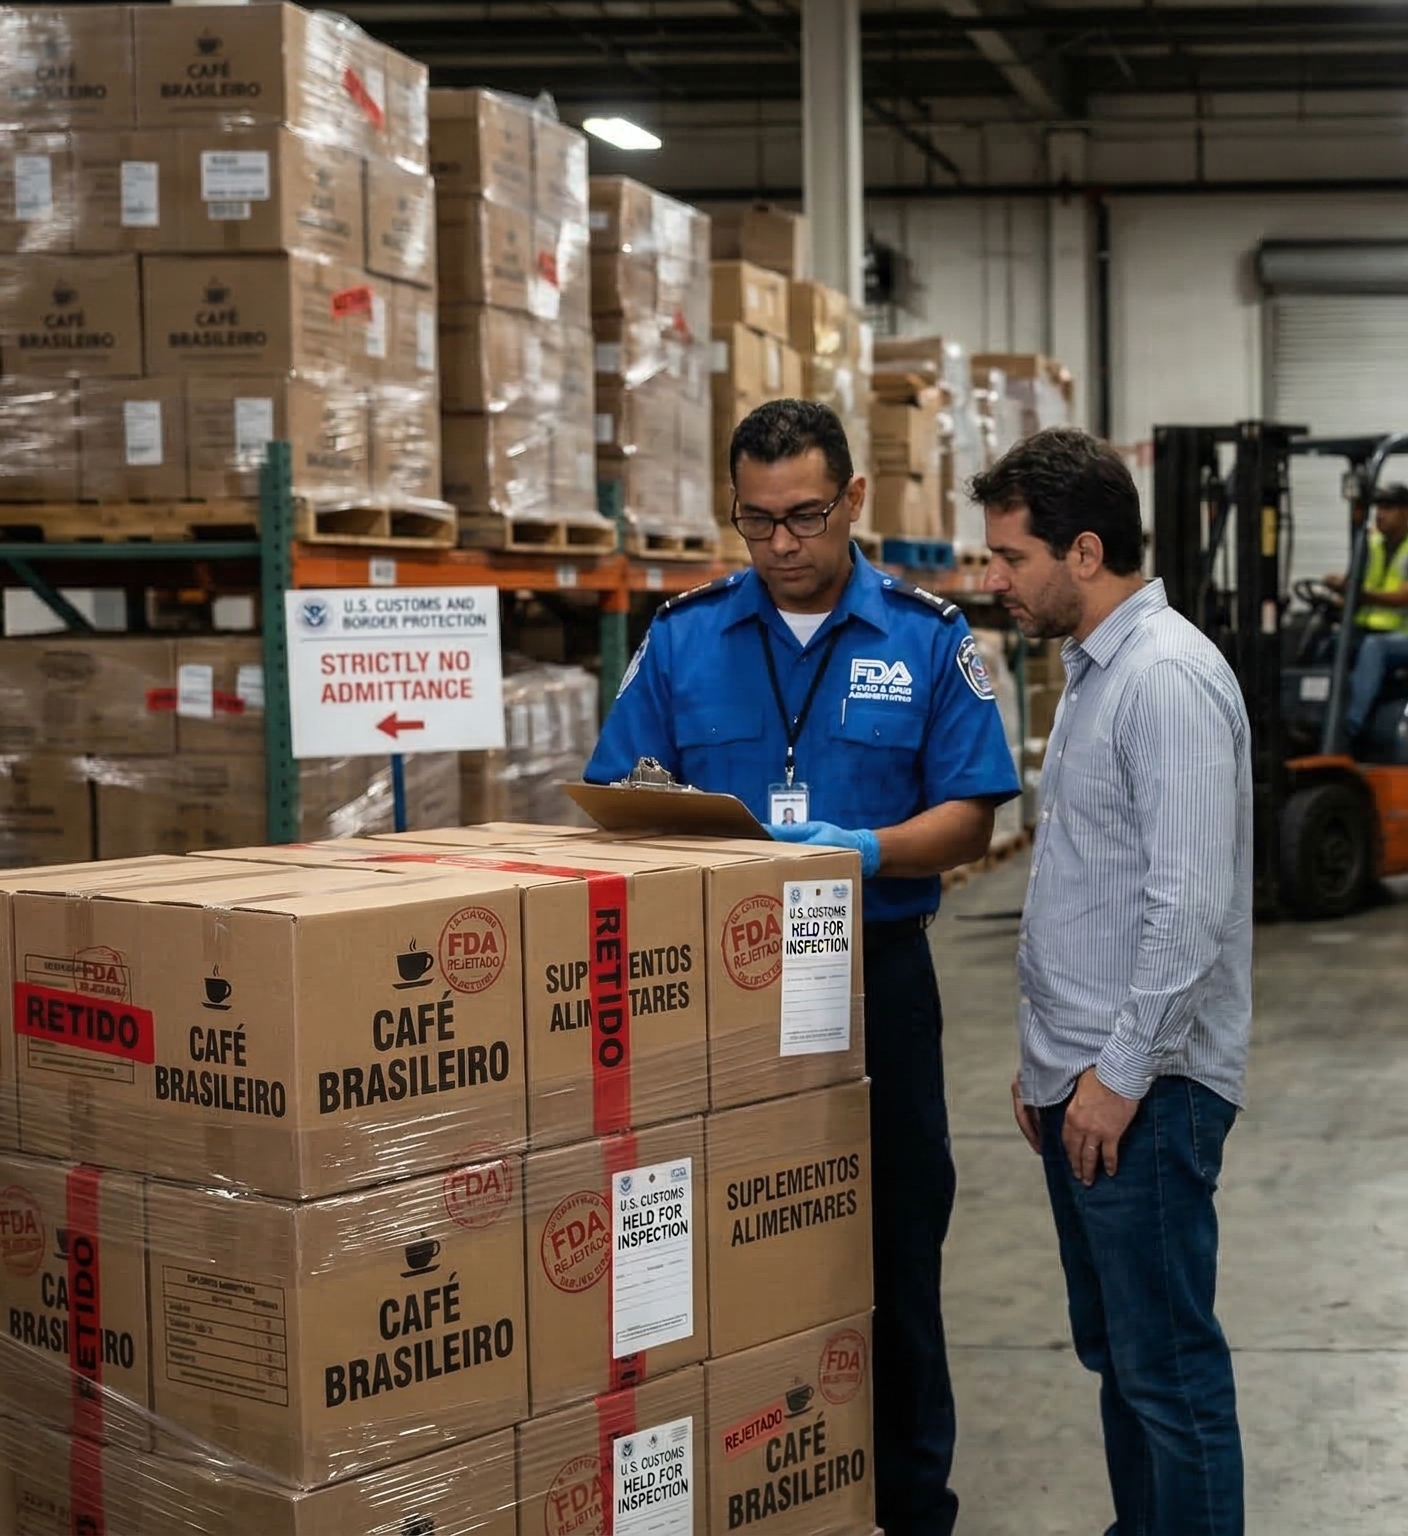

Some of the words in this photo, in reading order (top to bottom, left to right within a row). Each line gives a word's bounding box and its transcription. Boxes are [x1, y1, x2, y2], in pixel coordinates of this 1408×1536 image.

[186, 60, 231, 79] CAFÉ
[160, 80, 261, 99] BRASILEIRO
[44, 308, 85, 329] CAFÉ
[195, 307, 239, 326] CAFÉ
[342, 615, 398, 629] BORDER
[402, 613, 486, 628] PROTECTION
[344, 599, 371, 613] U.S.
[375, 598, 441, 613] CUSTOMS
[447, 597, 475, 610] AND
[321, 651, 430, 675] STRICTLY
[439, 650, 470, 671] NO
[850, 658, 913, 686] FDA
[321, 678, 472, 704] ADMITTANCE
[448, 931, 498, 957] FDA
[731, 914, 782, 953] FDA
[82, 961, 118, 983] FDA
[448, 956, 500, 971] REJEITADO
[546, 944, 692, 994] SUPENTOS
[596, 907, 624, 1068] RETIDO
[27, 994, 139, 1050] RETIDO
[373, 990, 455, 1051] CAFÉ
[550, 981, 690, 1033] ALITARES
[189, 1023, 247, 1067] CAFÉ
[155, 1065, 286, 1118] BRASILEIRO
[318, 1040, 509, 1115] BRASILEIRO
[451, 1169, 501, 1202] FDA
[620, 1197, 638, 1212] U.S.
[640, 1186, 684, 1208] CUSTOMS
[726, 1153, 860, 1211] SUPLEMENTOS
[0, 1209, 38, 1235] FDA
[551, 1210, 607, 1261] FDA
[617, 1219, 689, 1250] INSPECTION
[622, 1209, 654, 1231] HELD
[658, 1203, 683, 1224] FOR
[731, 1188, 858, 1247] ALIMENTARES
[41, 1272, 70, 1313] CA
[379, 1271, 461, 1341] CAFÉ
[74, 1236, 98, 1401] RETIDO
[10, 1307, 134, 1369] BRASIIRO
[325, 1317, 514, 1408] BRASILEIRO
[827, 1350, 860, 1371] FDA
[724, 1408, 783, 1453] REJEITADO
[766, 1411, 826, 1473] CAFÉ
[641, 1446, 685, 1470] CUSTOMS
[618, 1479, 689, 1514] INSPECTION
[623, 1472, 655, 1495] HELD
[659, 1463, 683, 1484] FOR
[728, 1448, 865, 1530] BRASILEIRO
[551, 1474, 605, 1522] FDA
